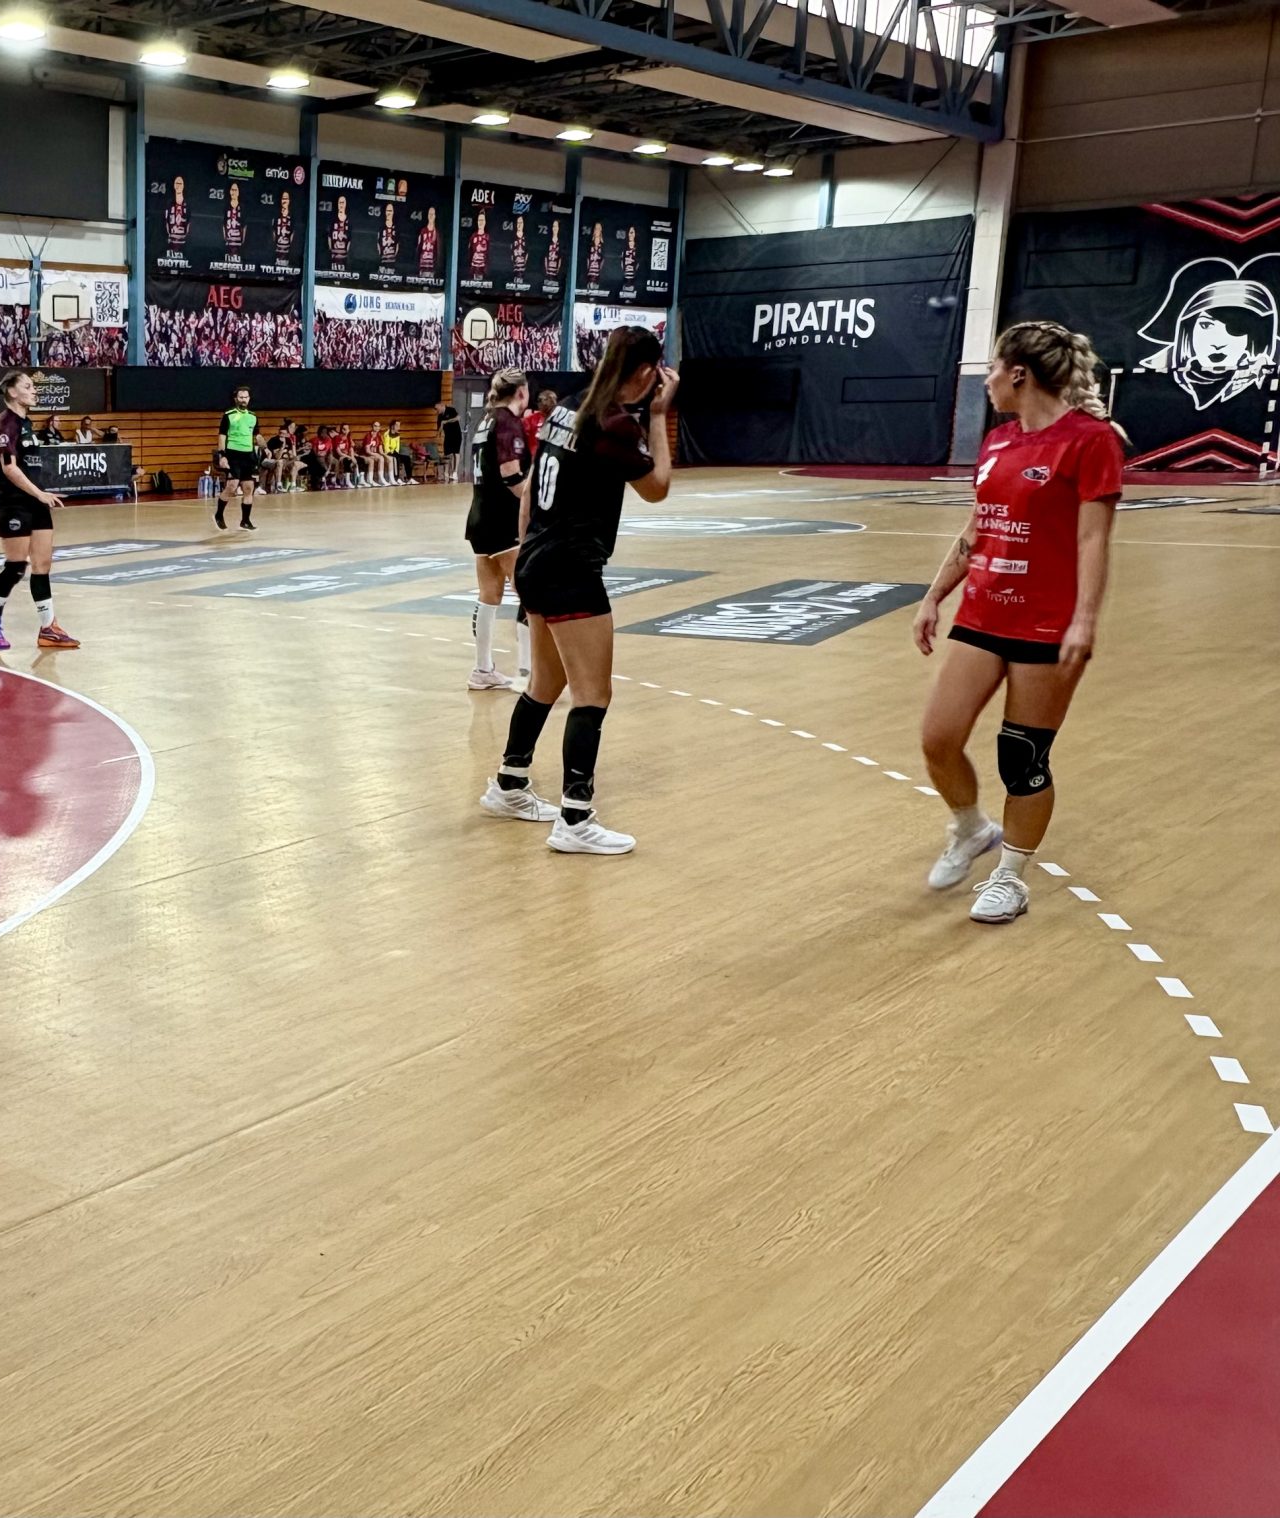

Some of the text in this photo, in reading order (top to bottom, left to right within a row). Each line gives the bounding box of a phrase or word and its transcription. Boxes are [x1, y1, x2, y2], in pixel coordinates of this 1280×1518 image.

[151, 182, 166, 194] 24
[207, 285, 243, 309] AEG
[498, 303, 523, 323] AEG
[752, 298, 876, 343] PIRATHS
[59, 452, 108, 475] PIRATHS
